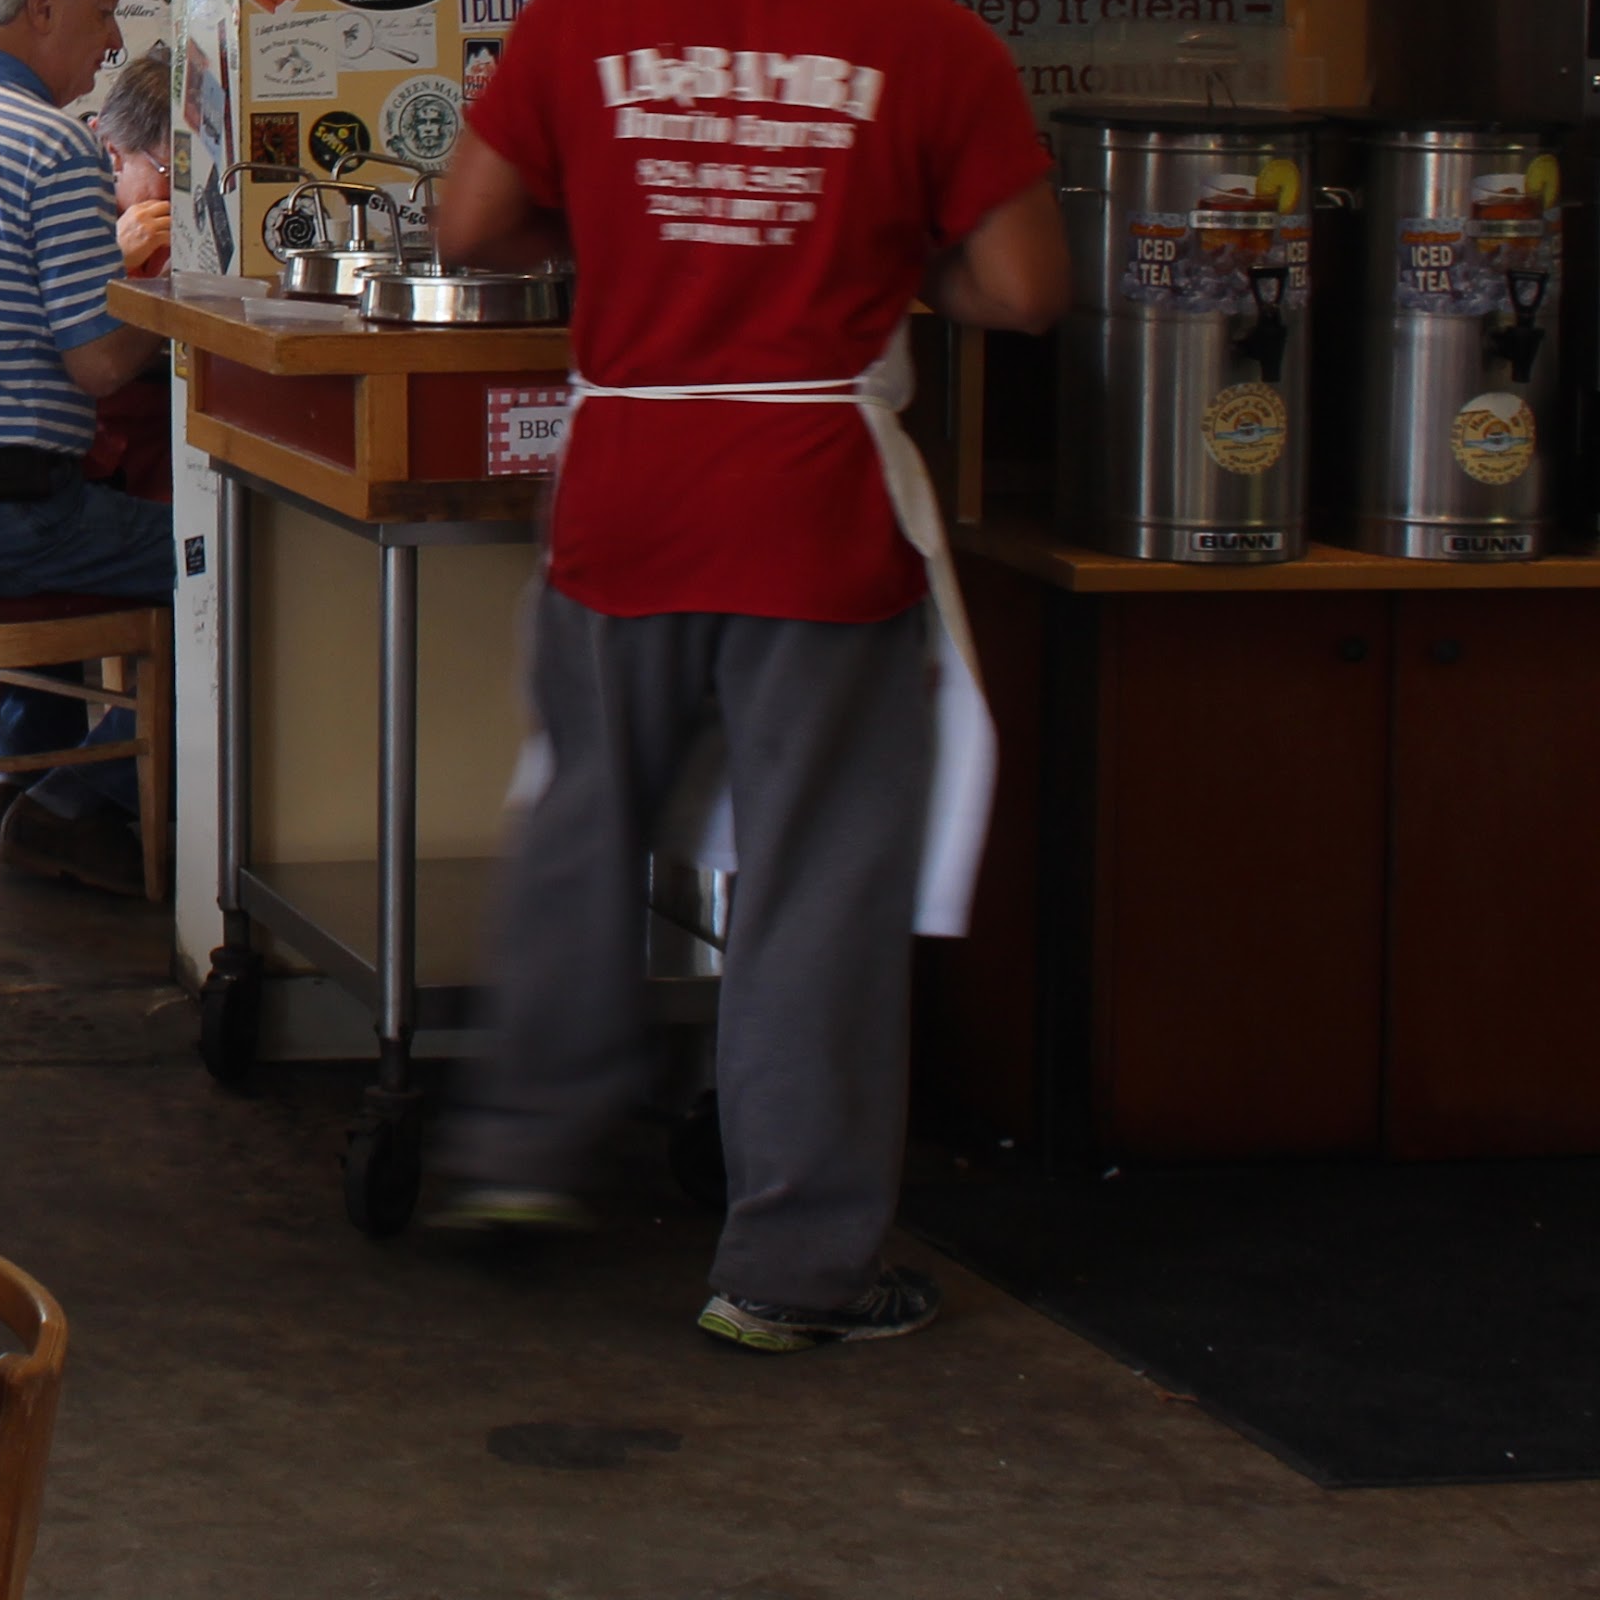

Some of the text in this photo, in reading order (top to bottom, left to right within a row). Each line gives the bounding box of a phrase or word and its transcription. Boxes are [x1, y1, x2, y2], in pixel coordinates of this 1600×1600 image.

[393, 80, 461, 109] GREEN MAN
[1137, 237, 1177, 262] ICED
[1411, 245, 1454, 269] ICED
[1139, 265, 1173, 287] TEA
[1414, 269, 1452, 293] TEA
[1200, 533, 1276, 550] BUNN
[1450, 536, 1528, 553] BUNN
